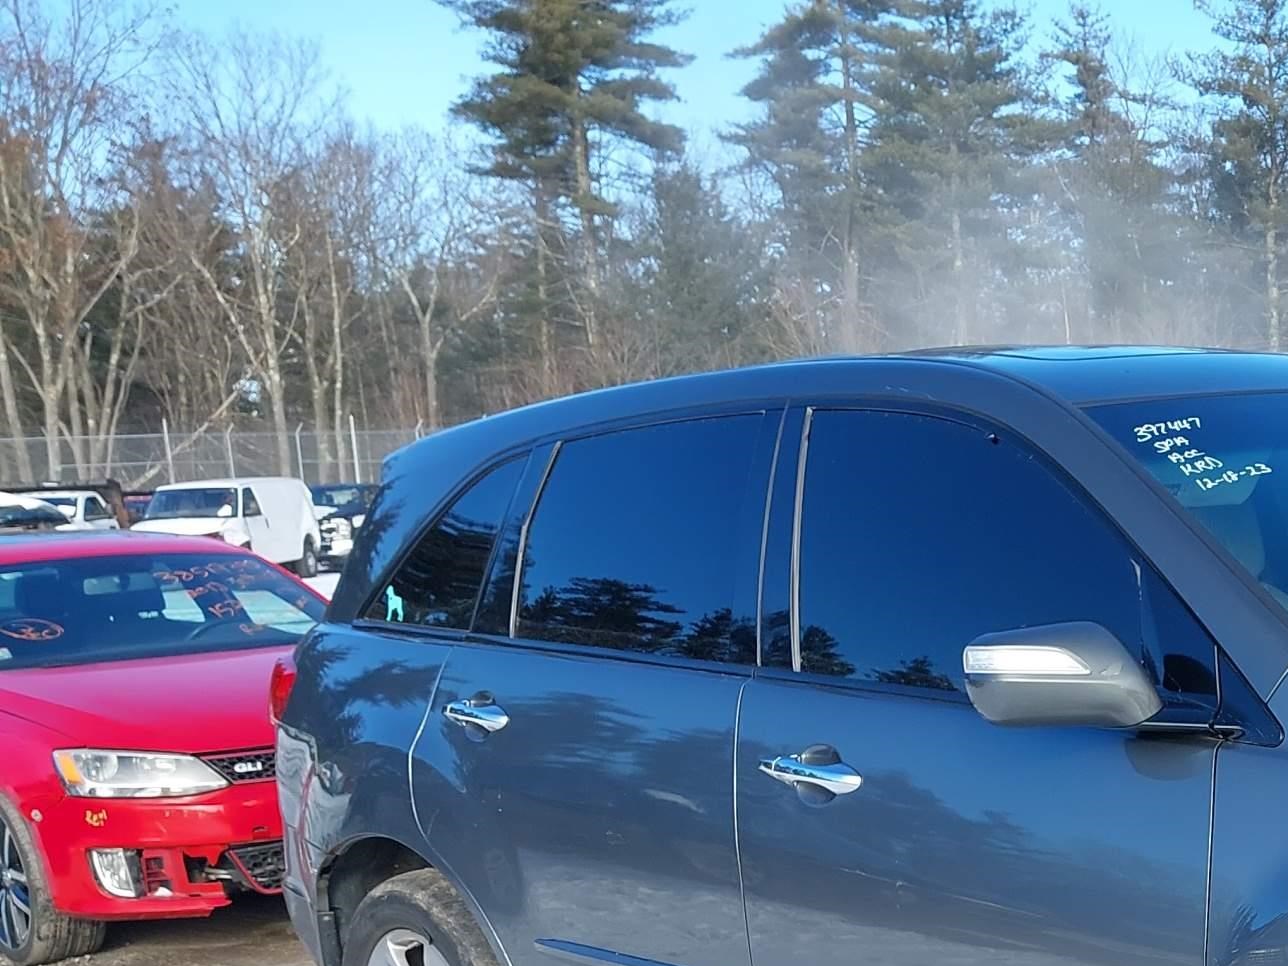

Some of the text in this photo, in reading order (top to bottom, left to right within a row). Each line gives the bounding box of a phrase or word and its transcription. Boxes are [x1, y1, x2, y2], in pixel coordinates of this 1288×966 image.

[1133, 416, 1201, 442] 397447
[1195, 463, 1272, 490] 12-18-23
[233, 761, 263, 773] GLI
